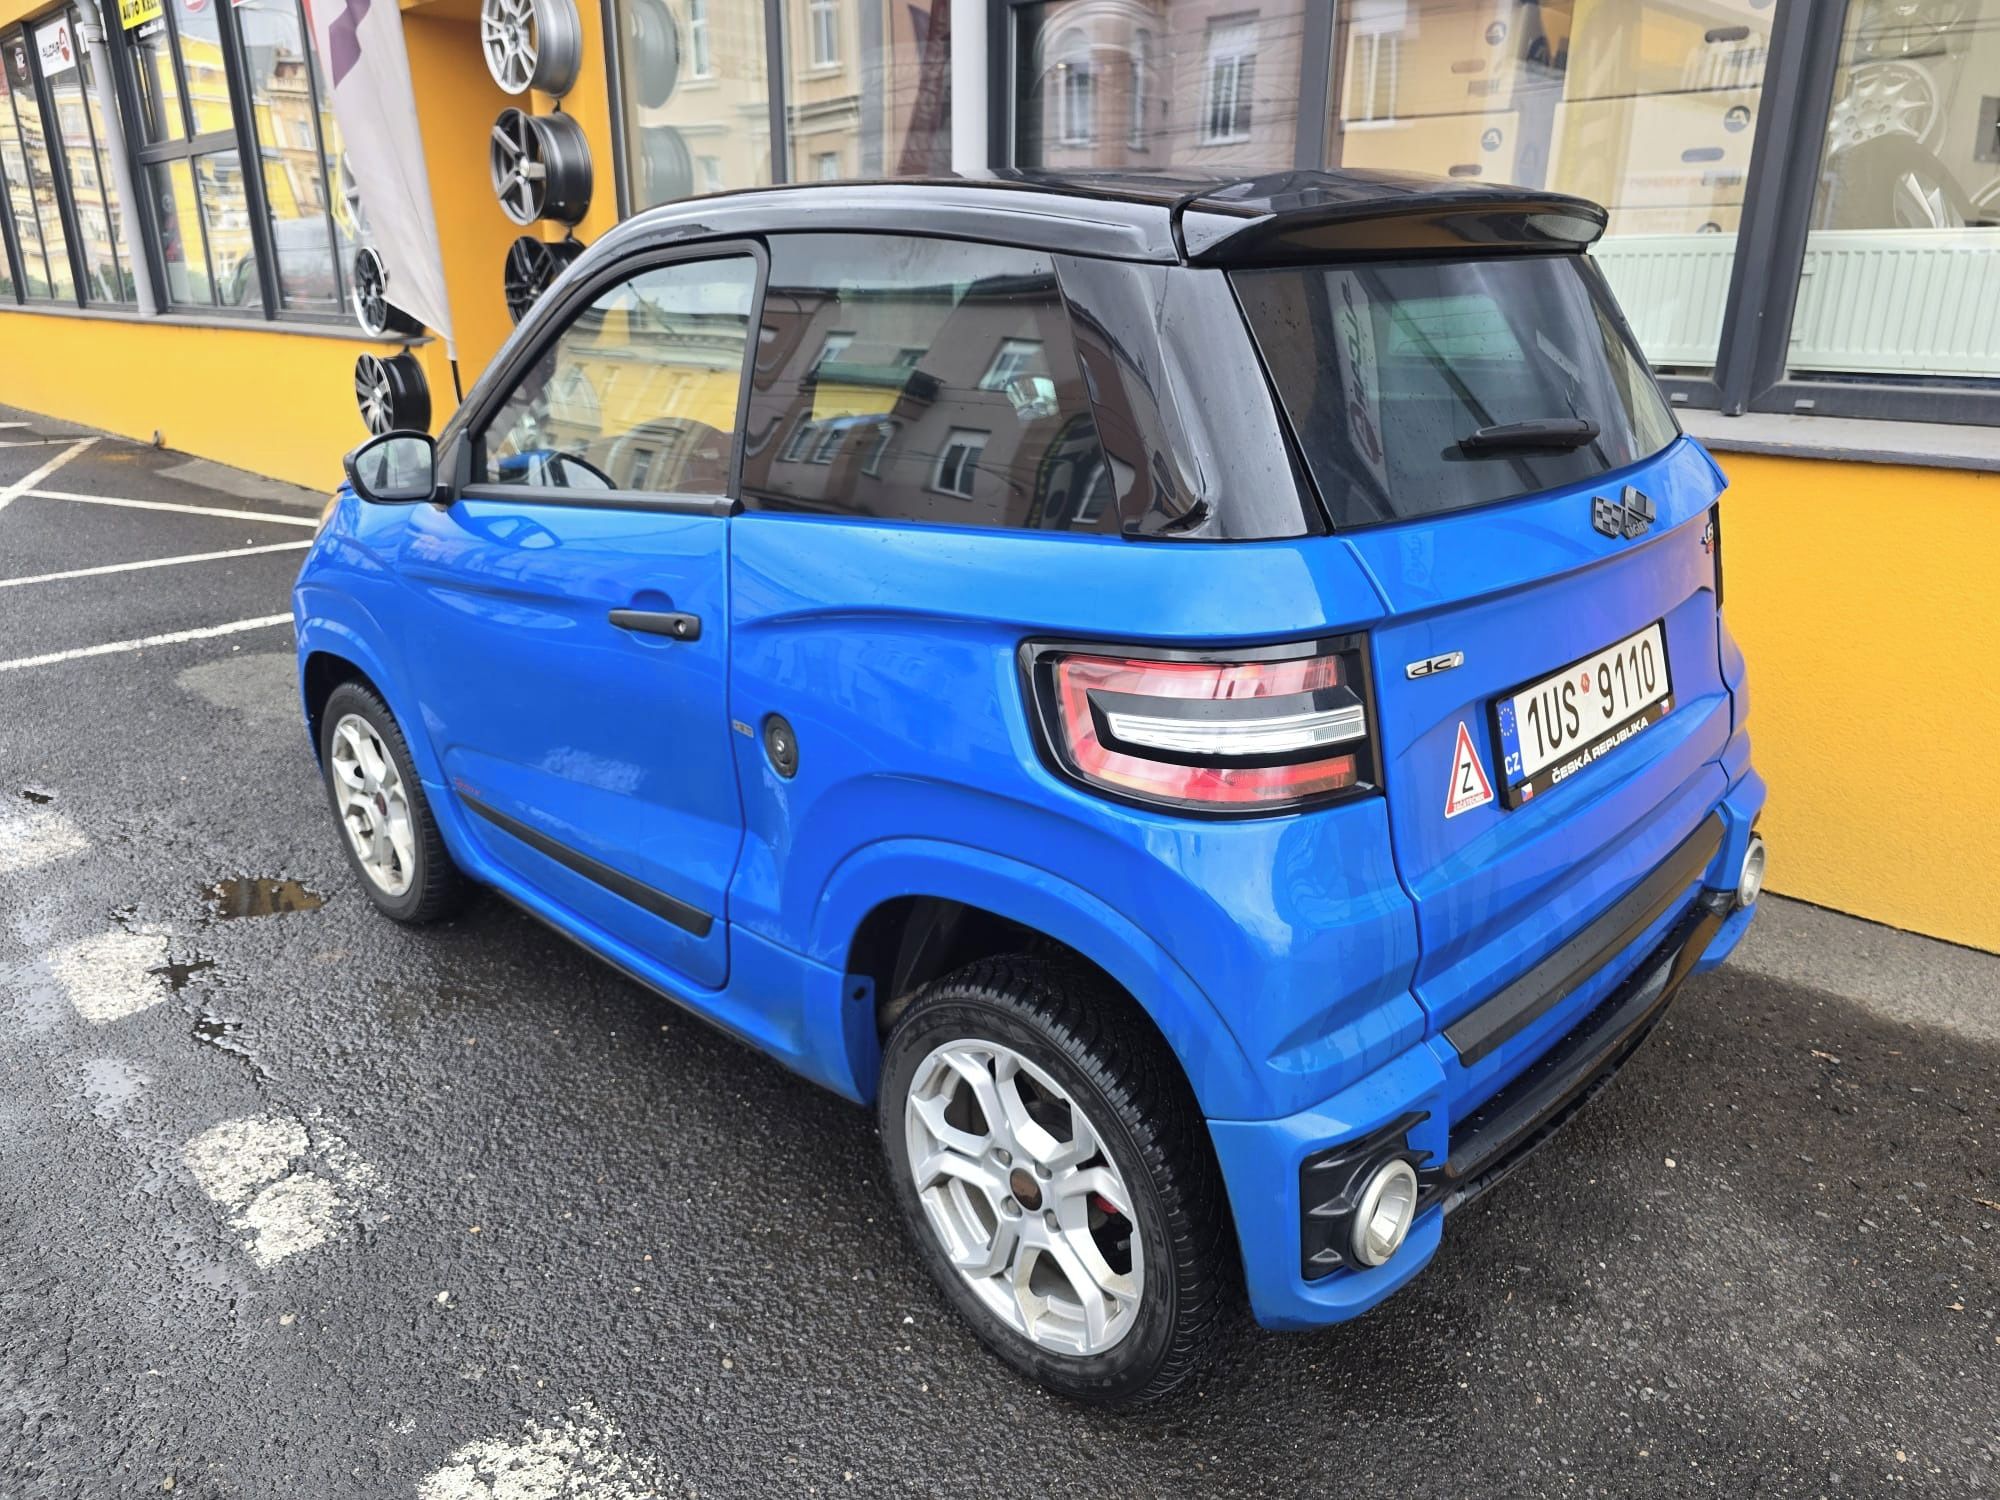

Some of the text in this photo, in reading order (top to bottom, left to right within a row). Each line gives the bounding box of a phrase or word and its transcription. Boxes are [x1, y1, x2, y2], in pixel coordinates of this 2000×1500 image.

[1528, 640, 1656, 758] 1US 9110
[1504, 751, 1521, 776] CZ
[1551, 716, 1649, 784] ČESKÁ REPUBLIKA
[1461, 762, 1474, 794] Z
